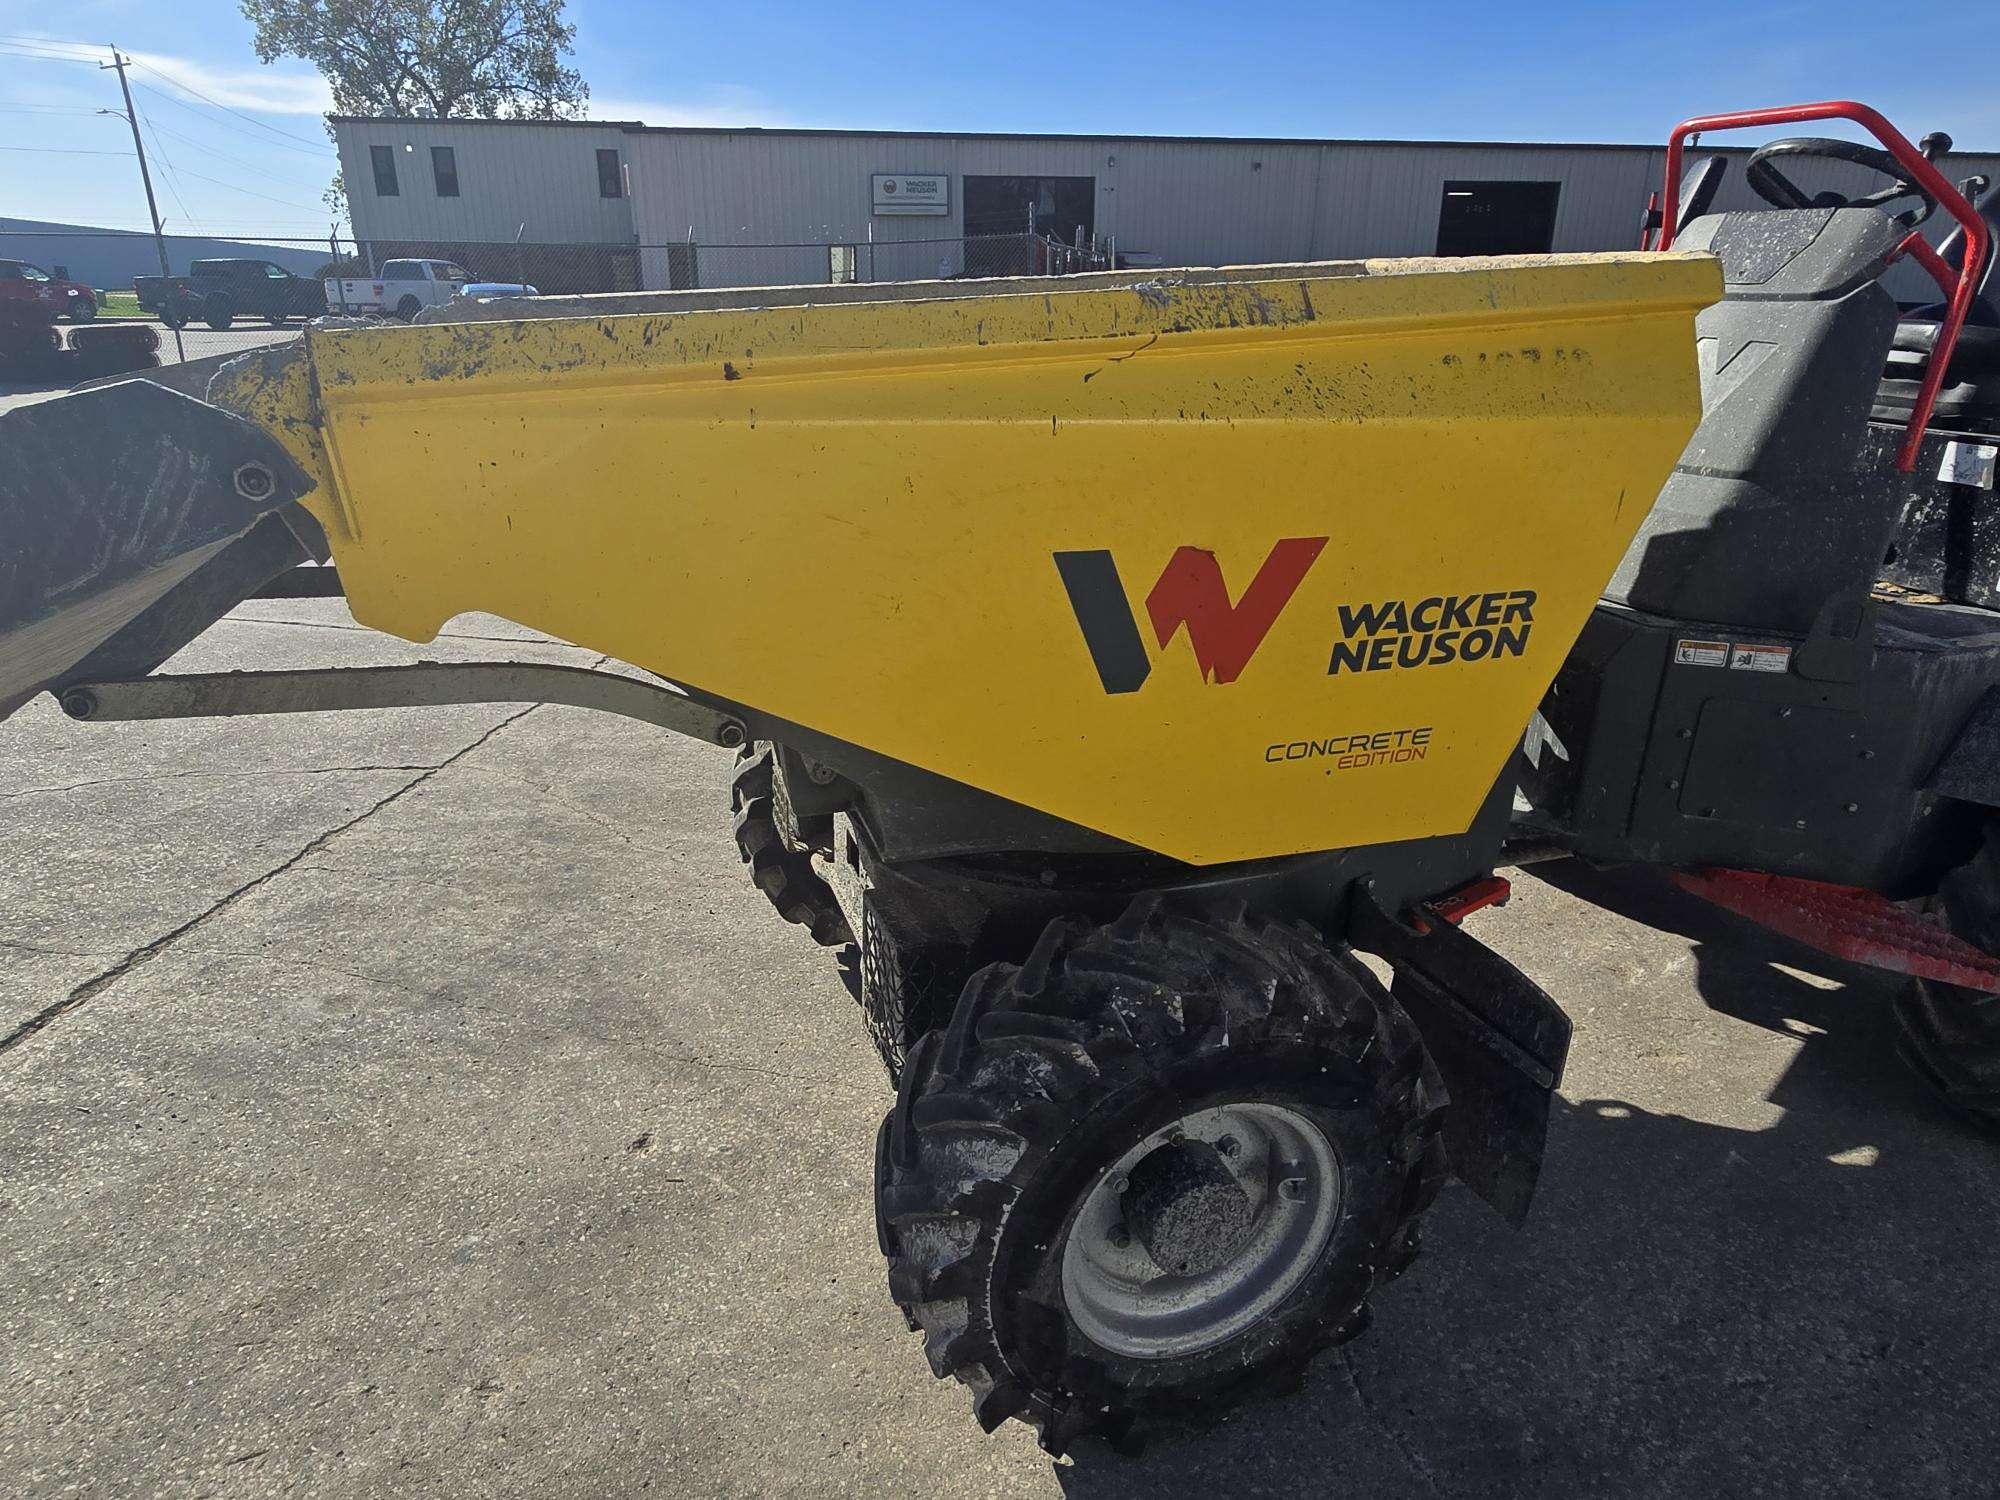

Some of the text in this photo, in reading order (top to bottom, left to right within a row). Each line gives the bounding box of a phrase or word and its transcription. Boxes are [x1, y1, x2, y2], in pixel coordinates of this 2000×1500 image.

[1337, 589, 1538, 639] WACKER
[1327, 623, 1532, 676] NEUSON
[1265, 727, 1433, 763] CONCRETE
[1337, 746, 1428, 770] EDITION
